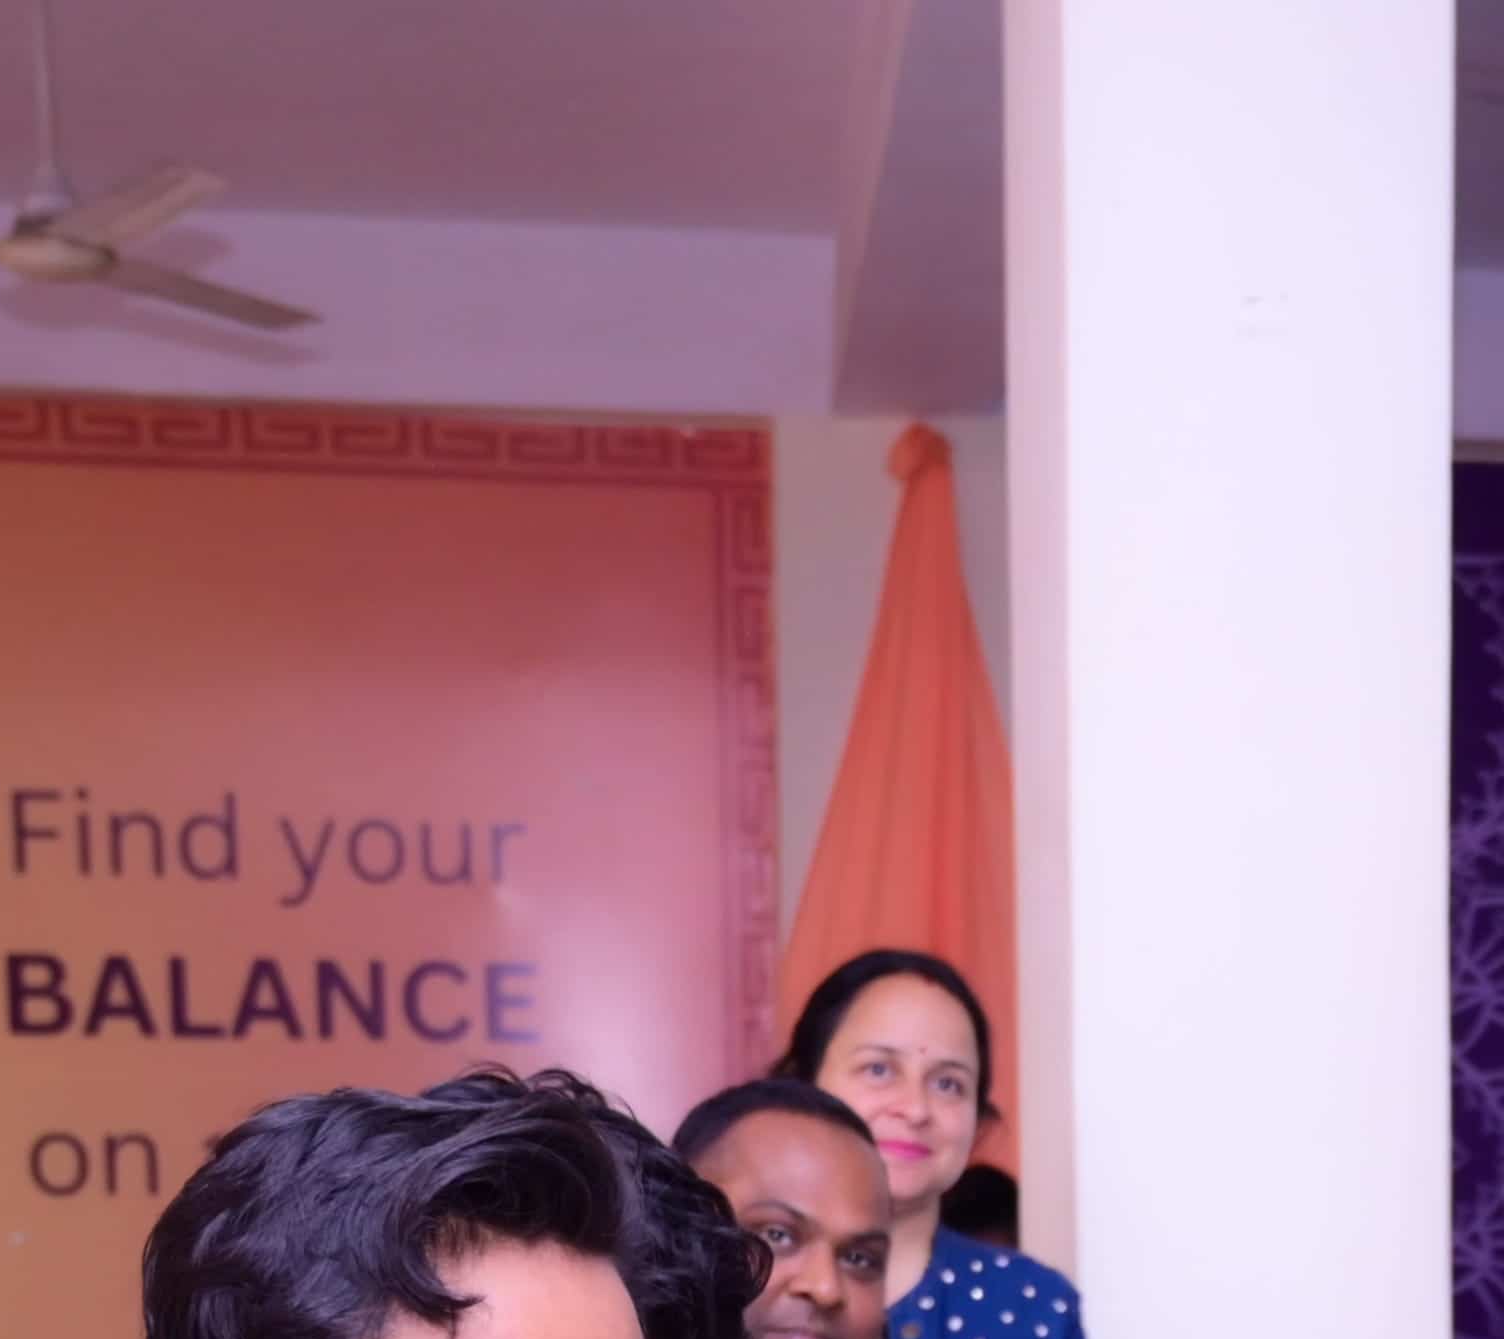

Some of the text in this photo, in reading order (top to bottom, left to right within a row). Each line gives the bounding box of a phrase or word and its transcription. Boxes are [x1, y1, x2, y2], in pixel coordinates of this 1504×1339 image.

[8, 789, 527, 907] Find your
[4, 951, 541, 1044] BALANCE
[29, 1128, 159, 1197] on
